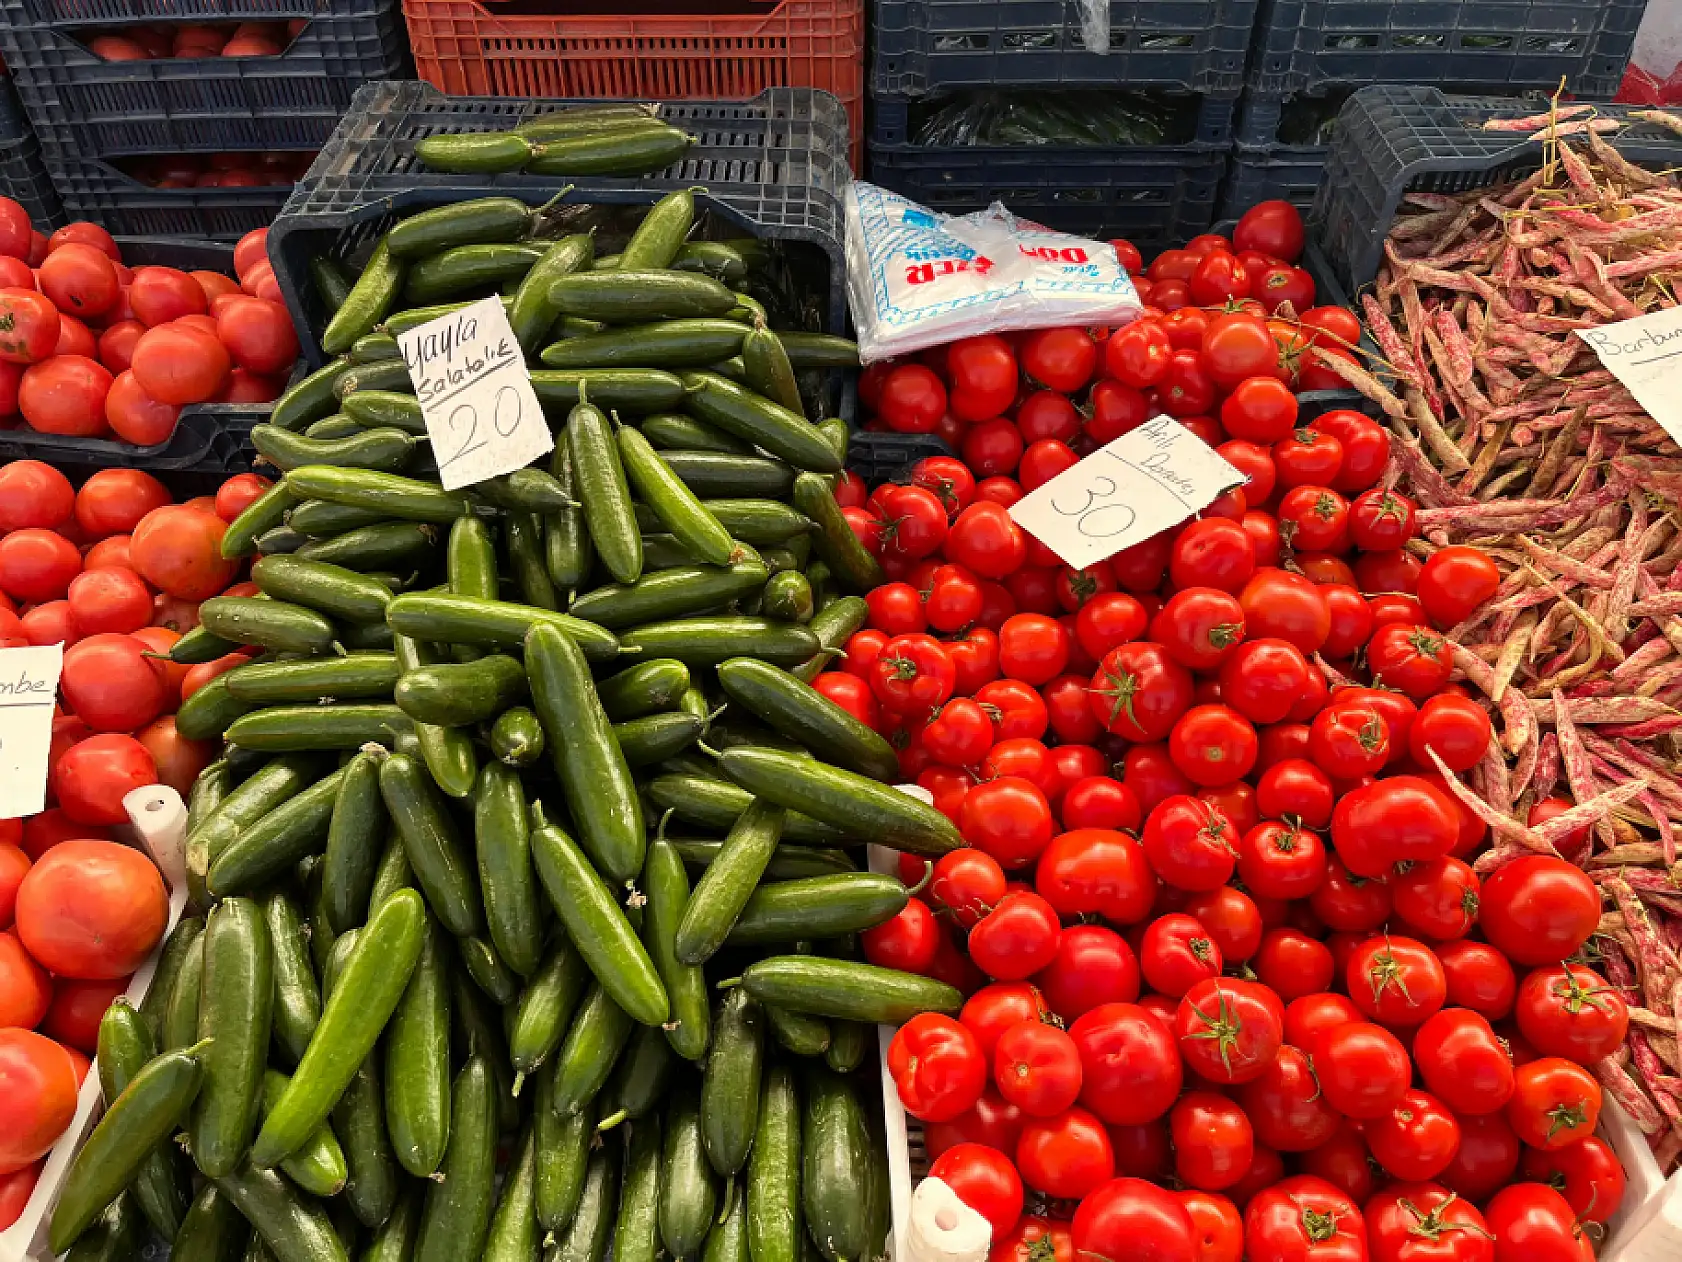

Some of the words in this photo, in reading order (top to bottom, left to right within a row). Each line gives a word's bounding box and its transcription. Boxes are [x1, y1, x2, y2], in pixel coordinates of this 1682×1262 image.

[403, 315, 478, 378] Yayla
[439, 385, 523, 470] 20
[1050, 475, 1136, 537] 30
